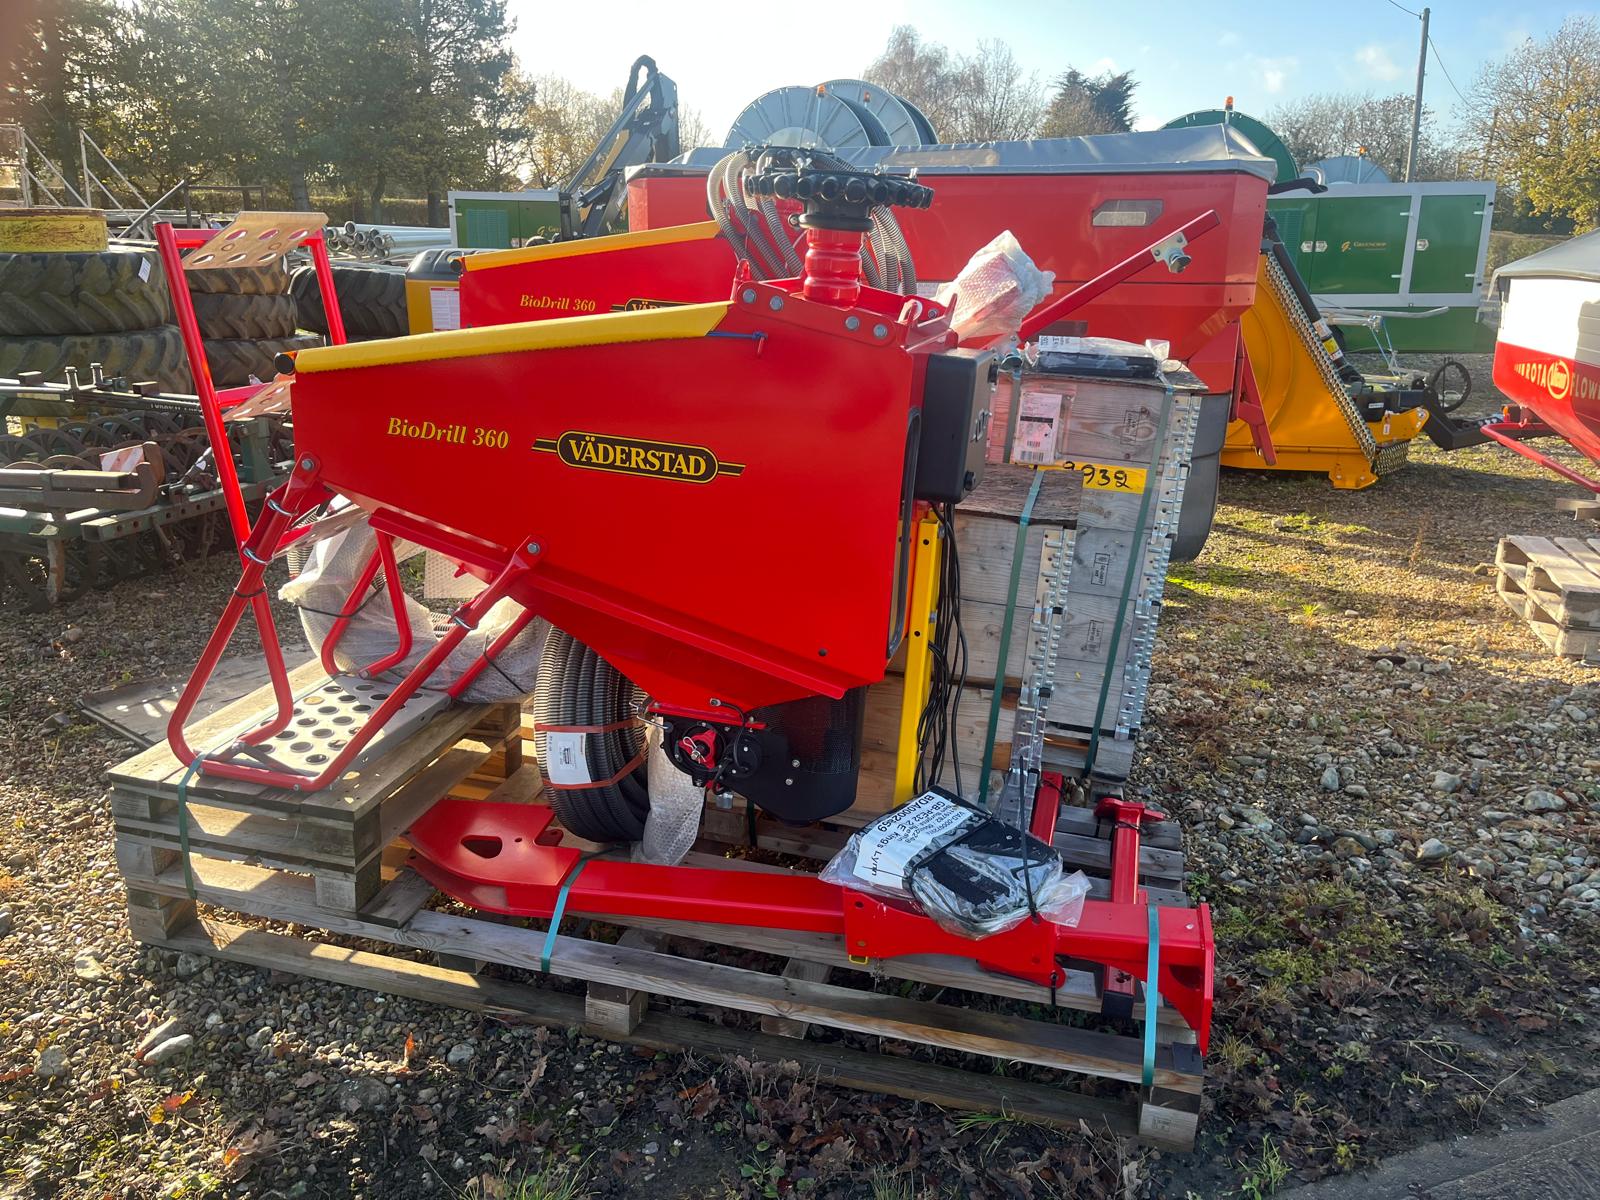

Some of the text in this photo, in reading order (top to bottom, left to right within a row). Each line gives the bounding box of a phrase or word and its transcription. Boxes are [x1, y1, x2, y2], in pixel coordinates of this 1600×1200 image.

[520, 294, 596, 312] BioDrill 360
[1525, 363, 1547, 388] ROTA
[387, 417, 509, 449] BioDrill 360
[569, 436, 707, 477] VÄDERSTAD
[913, 801, 946, 822] GB-PE32
[872, 851, 882, 876] Lynn
